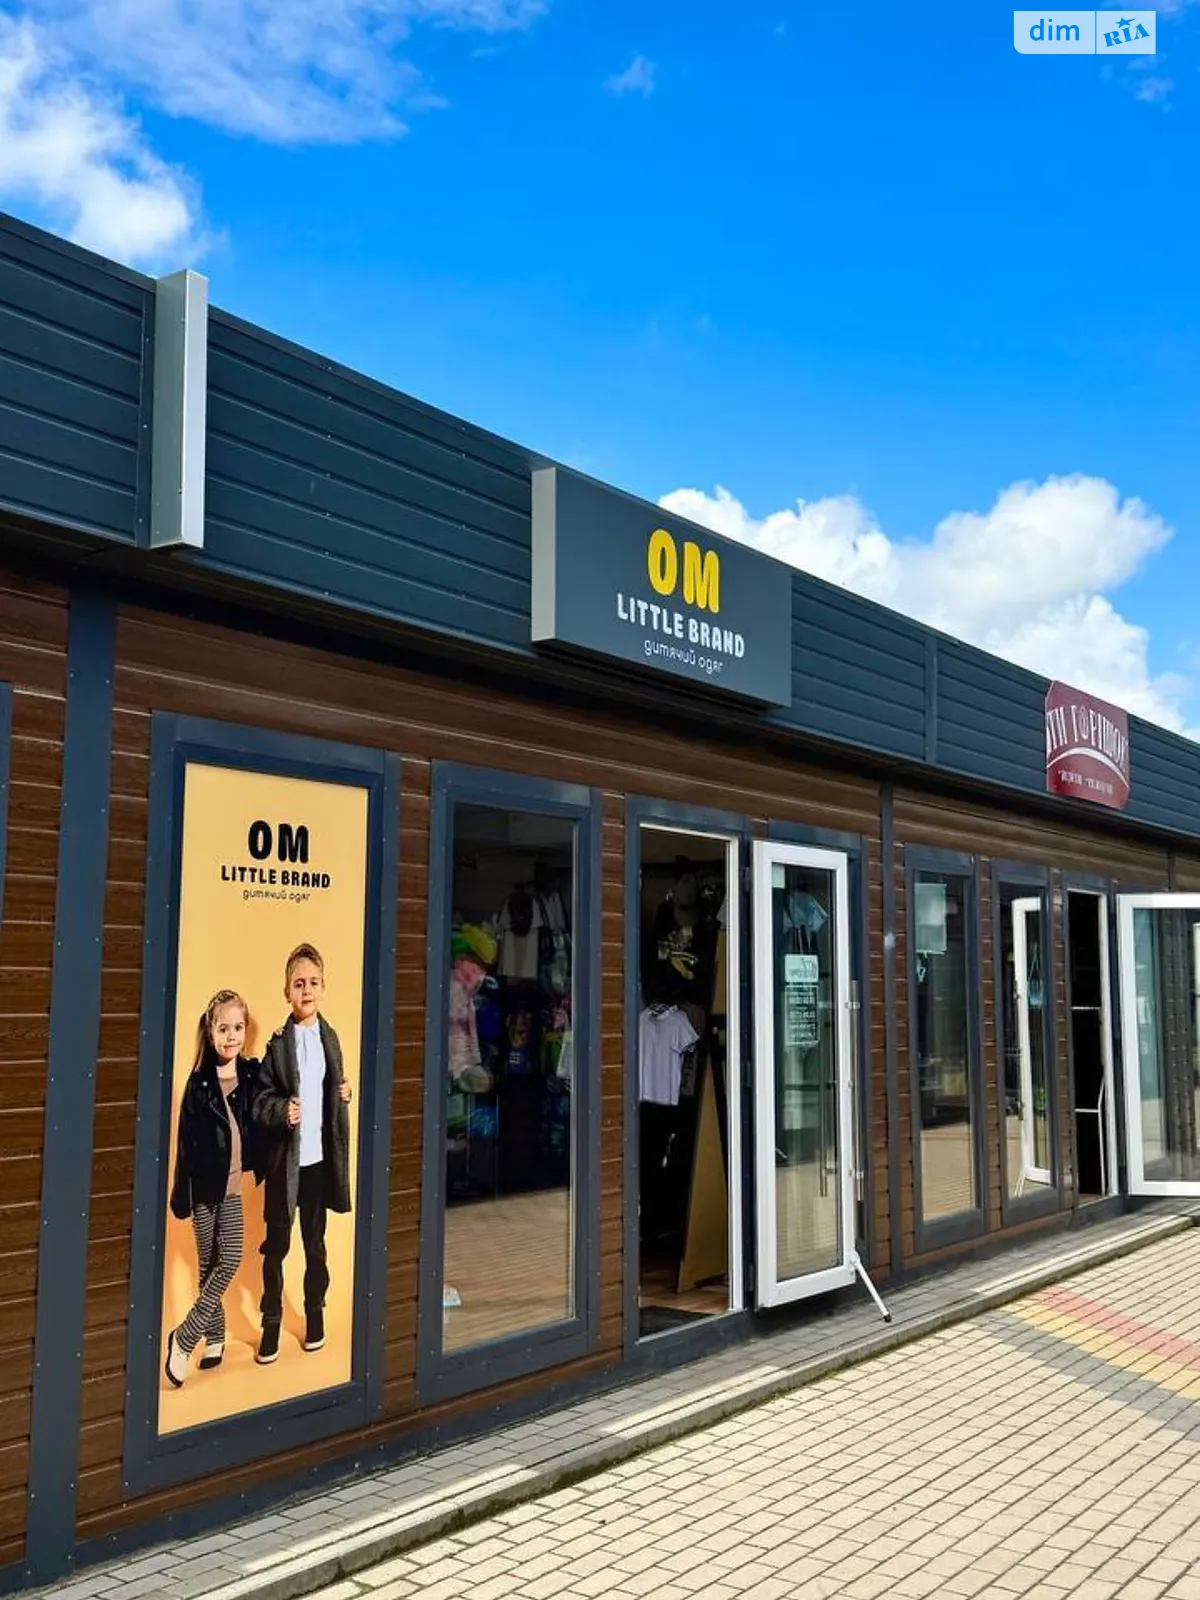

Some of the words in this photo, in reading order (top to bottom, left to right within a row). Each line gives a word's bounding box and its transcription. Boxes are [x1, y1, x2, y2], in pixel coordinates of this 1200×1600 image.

[648, 528, 720, 614] OM
[616, 592, 685, 639] LITTLE
[688, 618, 745, 658] BRAND
[248, 819, 309, 864] OM
[221, 865, 277, 885] LITTLE
[281, 870, 331, 888] BRAND
